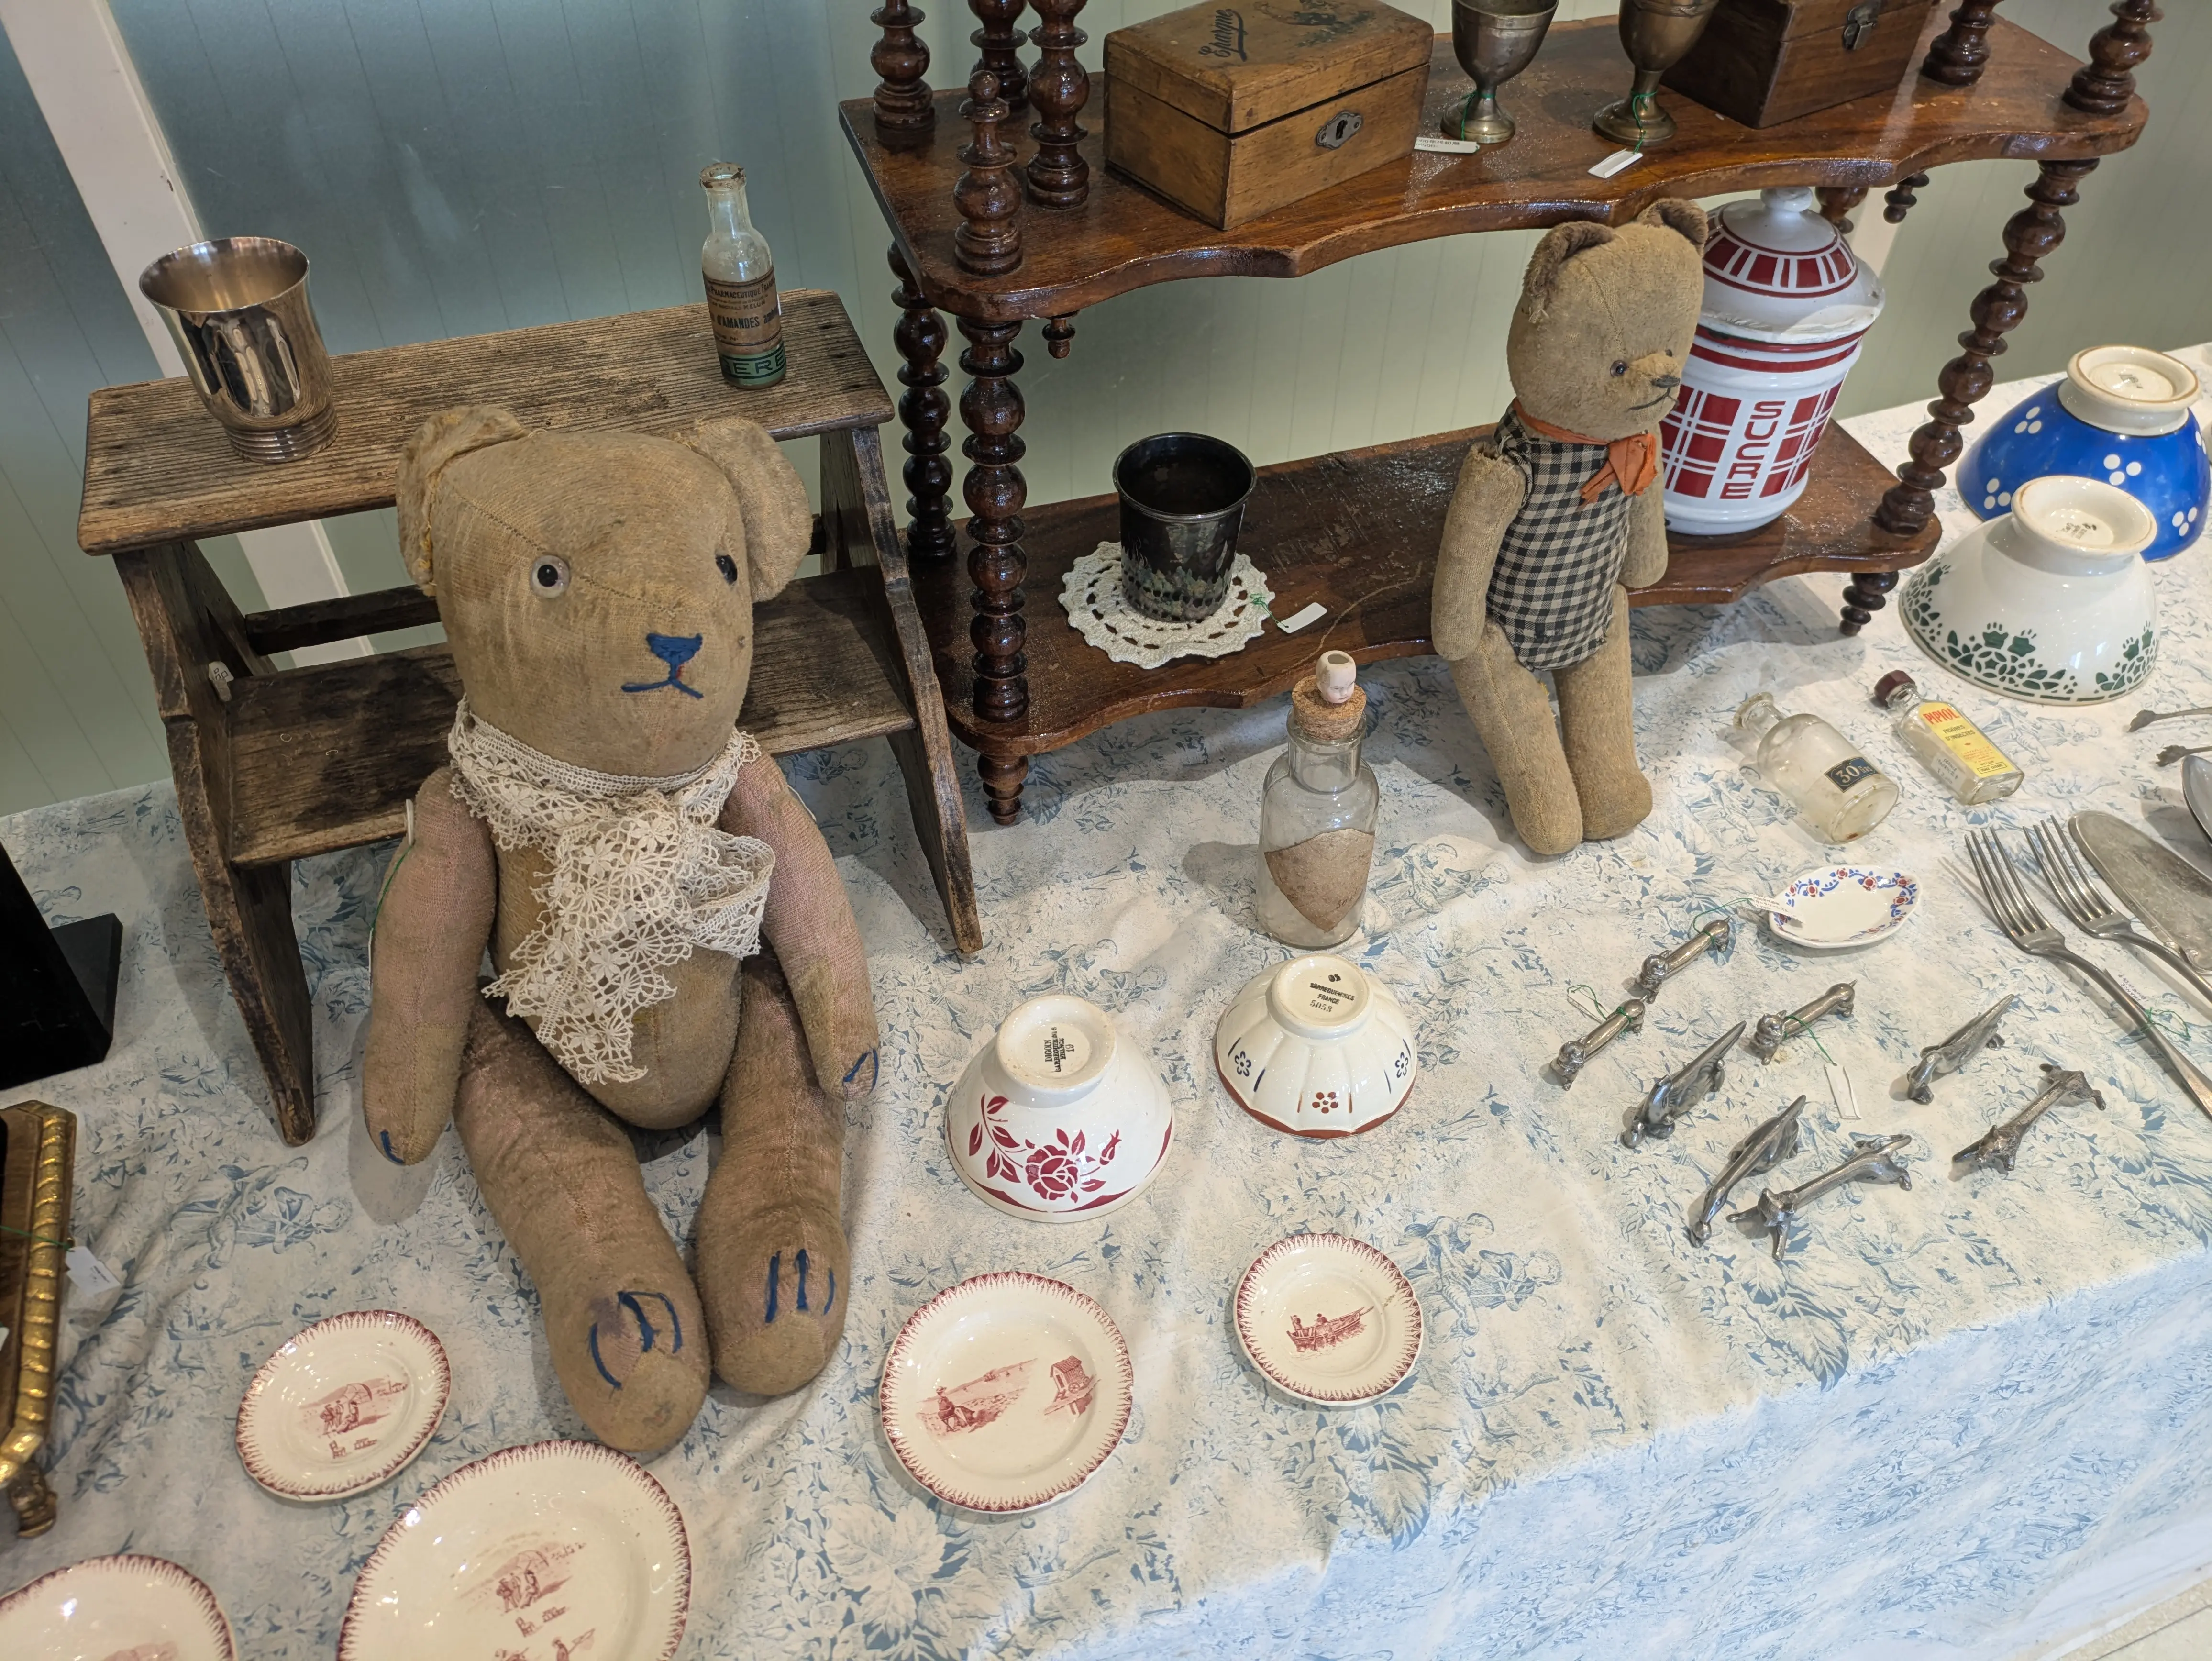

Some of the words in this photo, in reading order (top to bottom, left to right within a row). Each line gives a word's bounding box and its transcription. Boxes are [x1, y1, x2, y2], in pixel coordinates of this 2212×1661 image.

[711, 286, 761, 299] PHARMACEUTIQUE
[1719, 401, 1786, 499] SUCRE
[1923, 708, 1960, 724] PIPIOL
[1835, 765, 1860, 783] 30
[1309, 982, 1355, 1001] SARREGUEMINES
[1317, 993, 1340, 1005] FRANCE
[1044, 1039, 1053, 1062] DIGOIN
[1058, 1038, 1067, 1060] FRANCE
